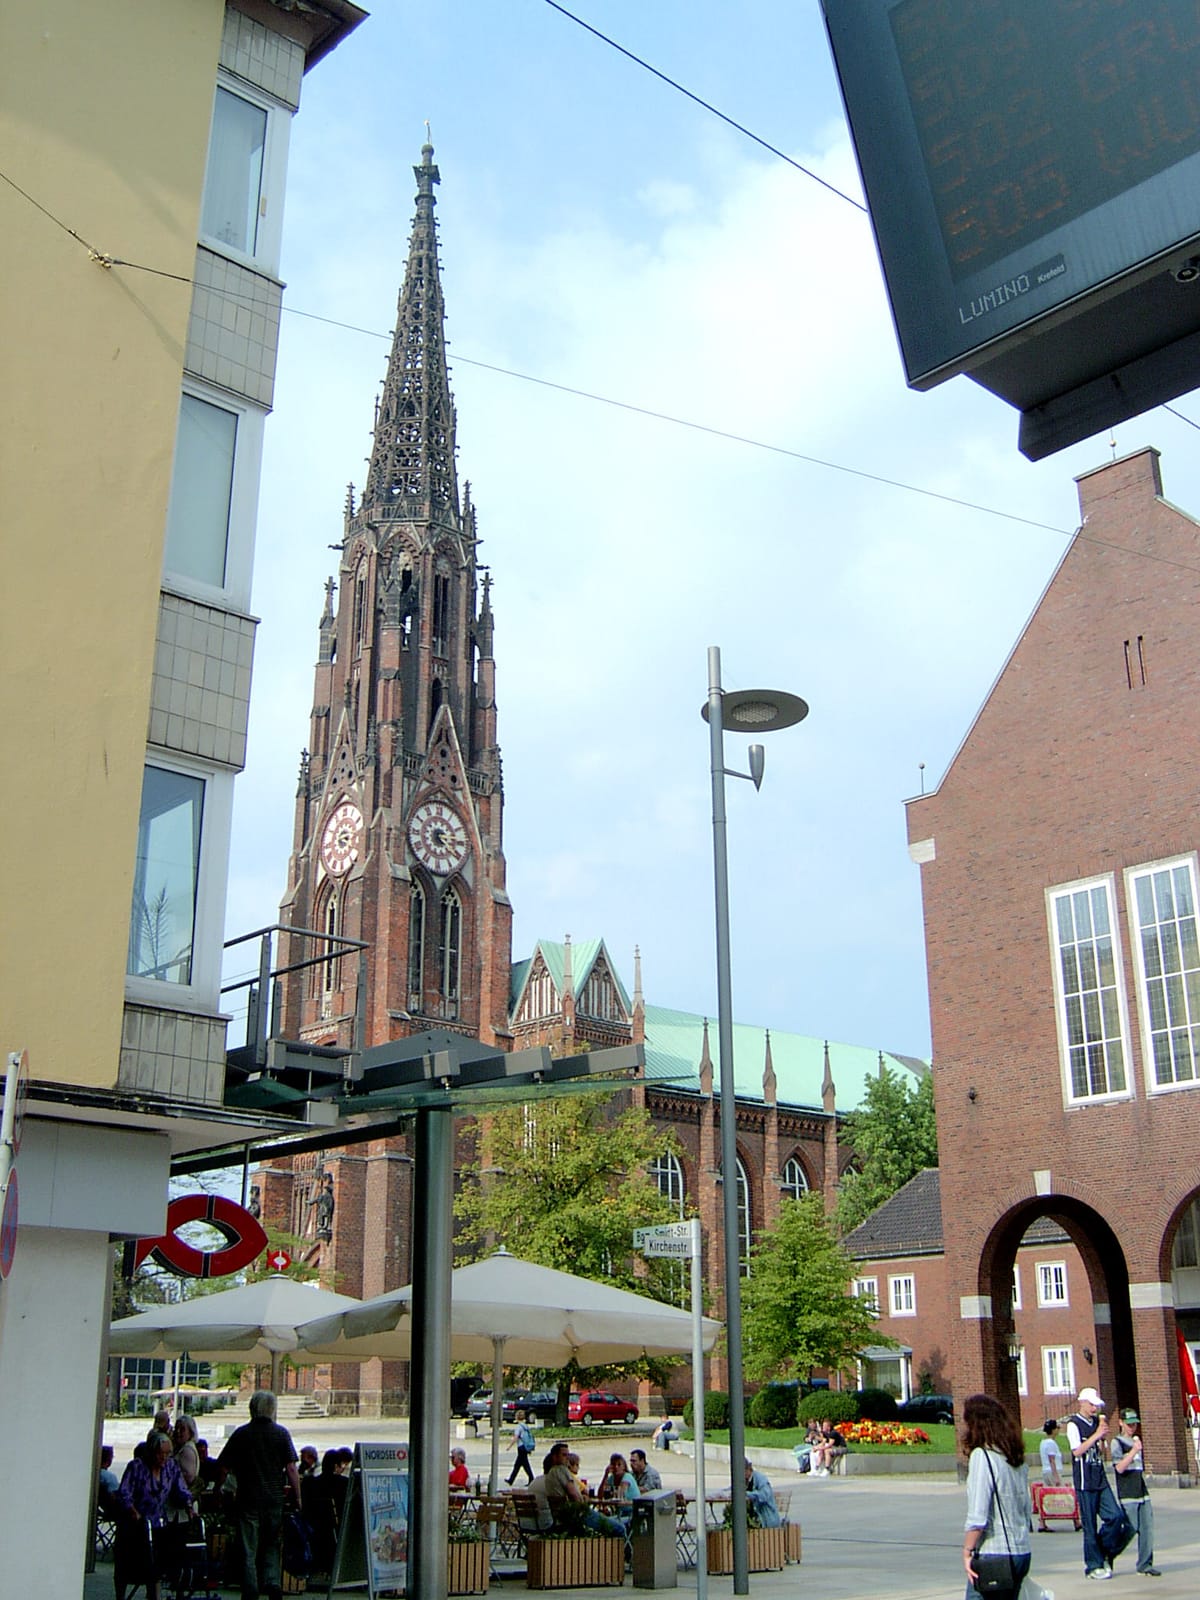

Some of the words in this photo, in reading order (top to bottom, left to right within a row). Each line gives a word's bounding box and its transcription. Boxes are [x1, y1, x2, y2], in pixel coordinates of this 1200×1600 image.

[958, 274, 1030, 324] LUMINO
[1037, 263, 1065, 284] Krefeld
[365, 1449, 396, 1460] NORDSEE
[368, 1476, 392, 1488] MACH
[369, 1491, 388, 1503] DICH
